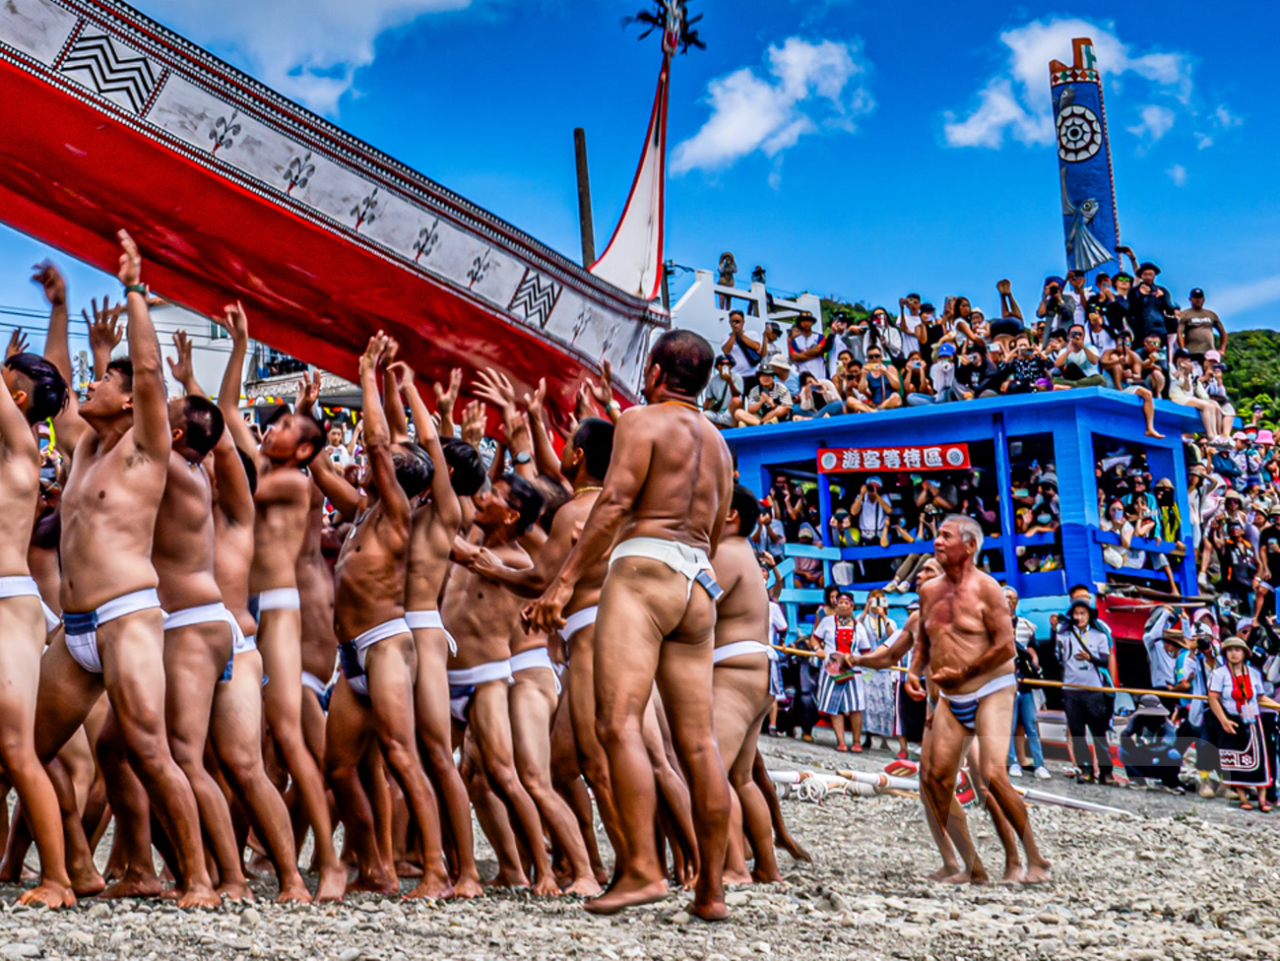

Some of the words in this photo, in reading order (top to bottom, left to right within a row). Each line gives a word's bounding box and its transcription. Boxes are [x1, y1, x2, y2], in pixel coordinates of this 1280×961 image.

[841, 446, 944, 470] 遊客等待區
